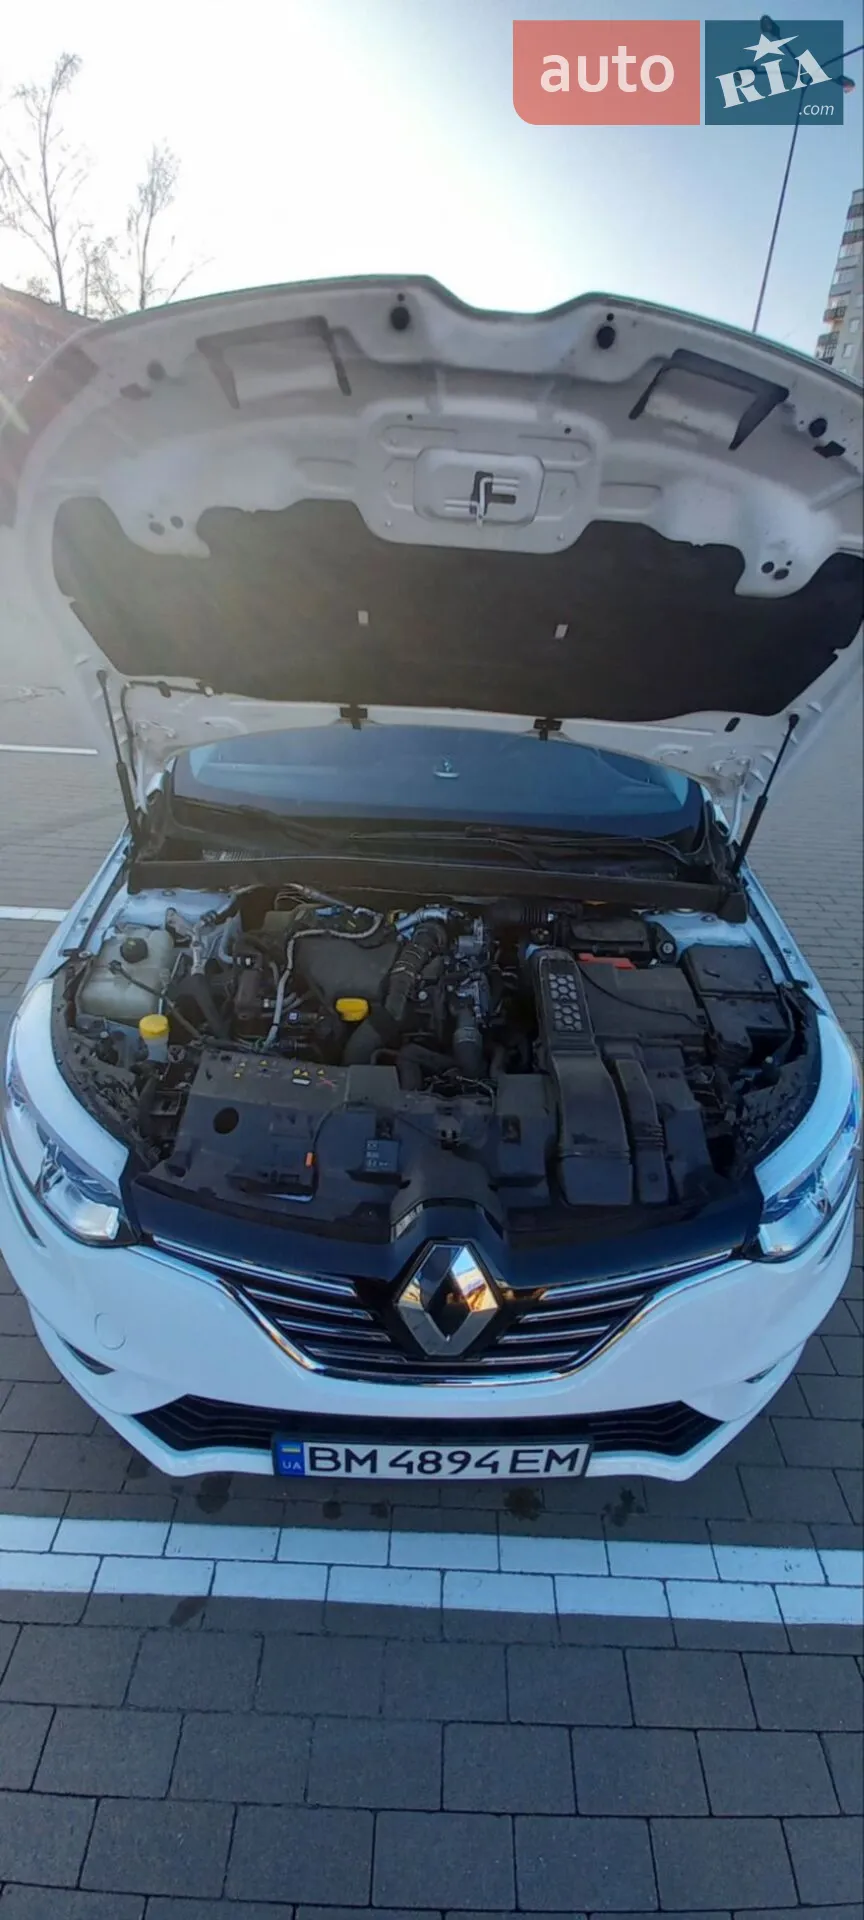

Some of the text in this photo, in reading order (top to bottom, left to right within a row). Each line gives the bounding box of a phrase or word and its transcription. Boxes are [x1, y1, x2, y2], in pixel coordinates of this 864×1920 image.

[282, 1461, 302, 1470] UA
[308, 1446, 581, 1475] BM 4894 EM
